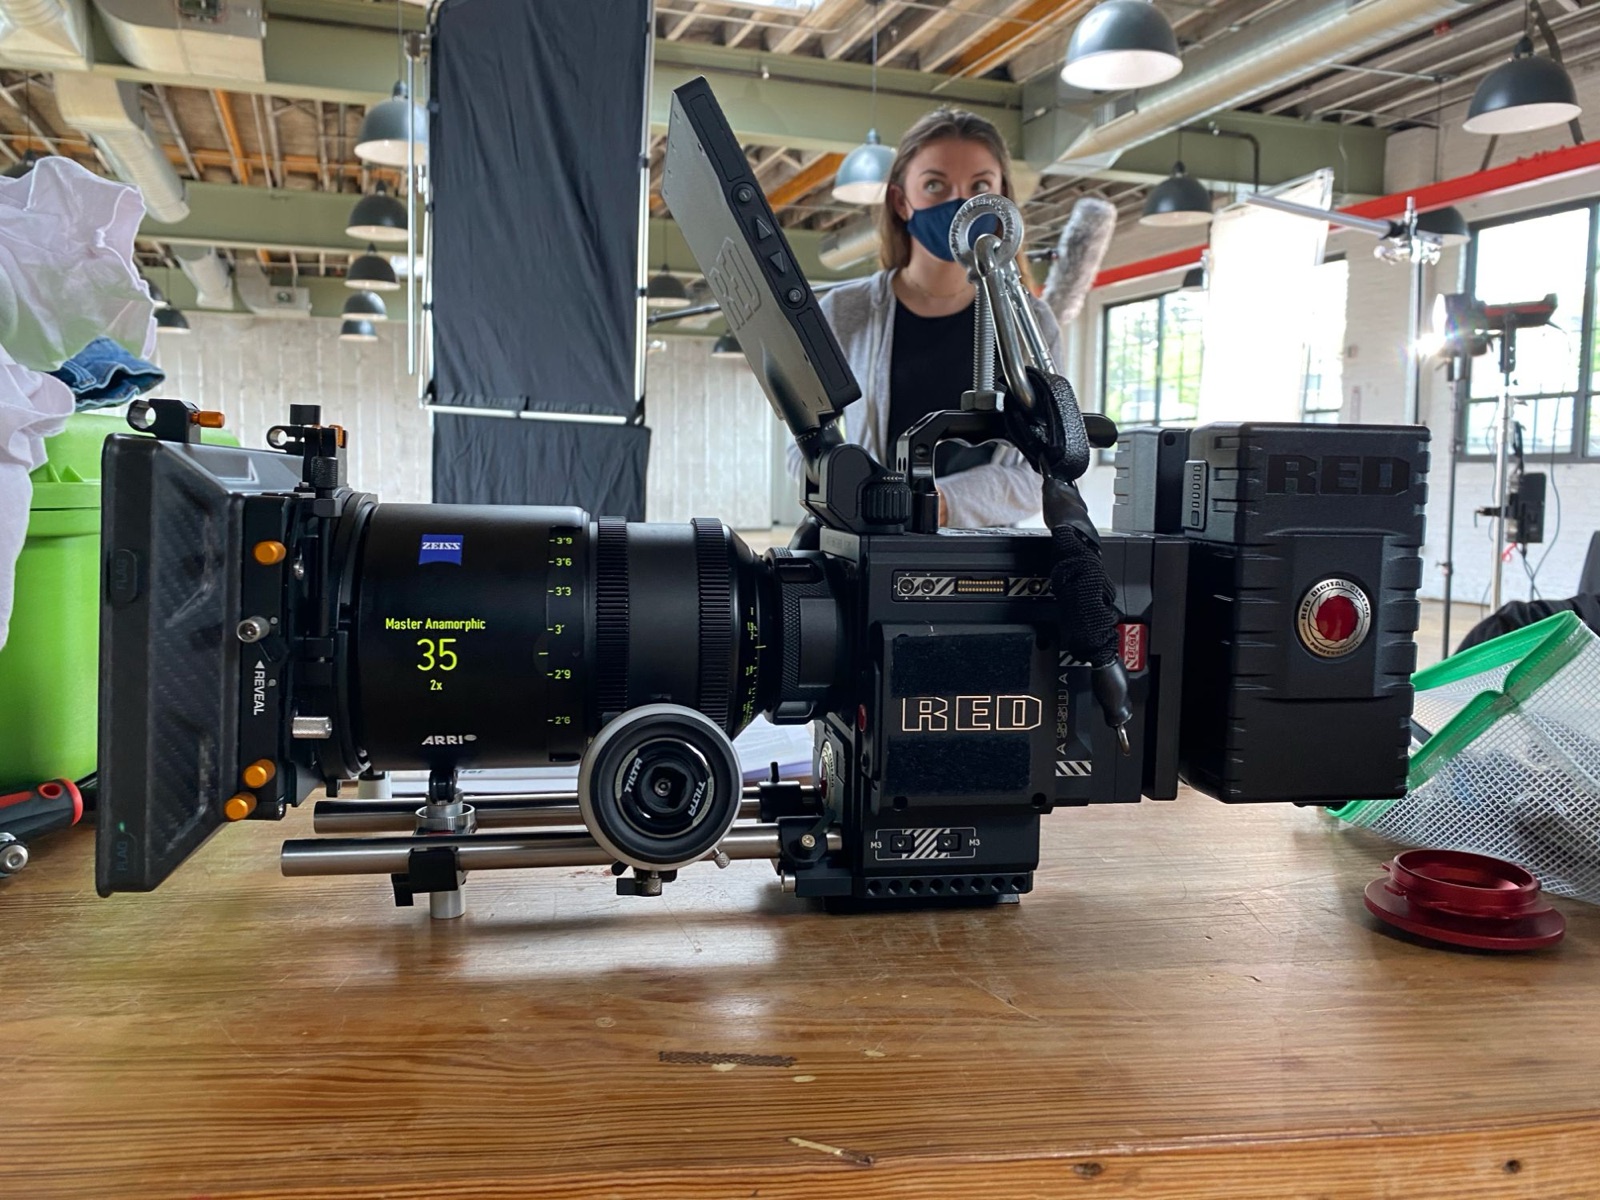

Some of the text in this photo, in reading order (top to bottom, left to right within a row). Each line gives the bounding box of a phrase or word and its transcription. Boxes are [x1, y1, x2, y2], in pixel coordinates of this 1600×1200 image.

[1265, 454, 1411, 496] RED
[421, 541, 461, 550] ZEISS
[1301, 581, 1370, 620] RED DIGITAL CINEMA
[385, 617, 486, 632] Master Anamorphic
[416, 638, 457, 671] 35
[253, 670, 265, 716] REVEAL
[430, 679, 443, 691] 2x
[902, 694, 1042, 732] RED
[421, 735, 464, 746] ARRI
[624, 757, 643, 793] TILTA
[687, 781, 706, 817] TILTA
[870, 838, 981, 849] M3 M3
